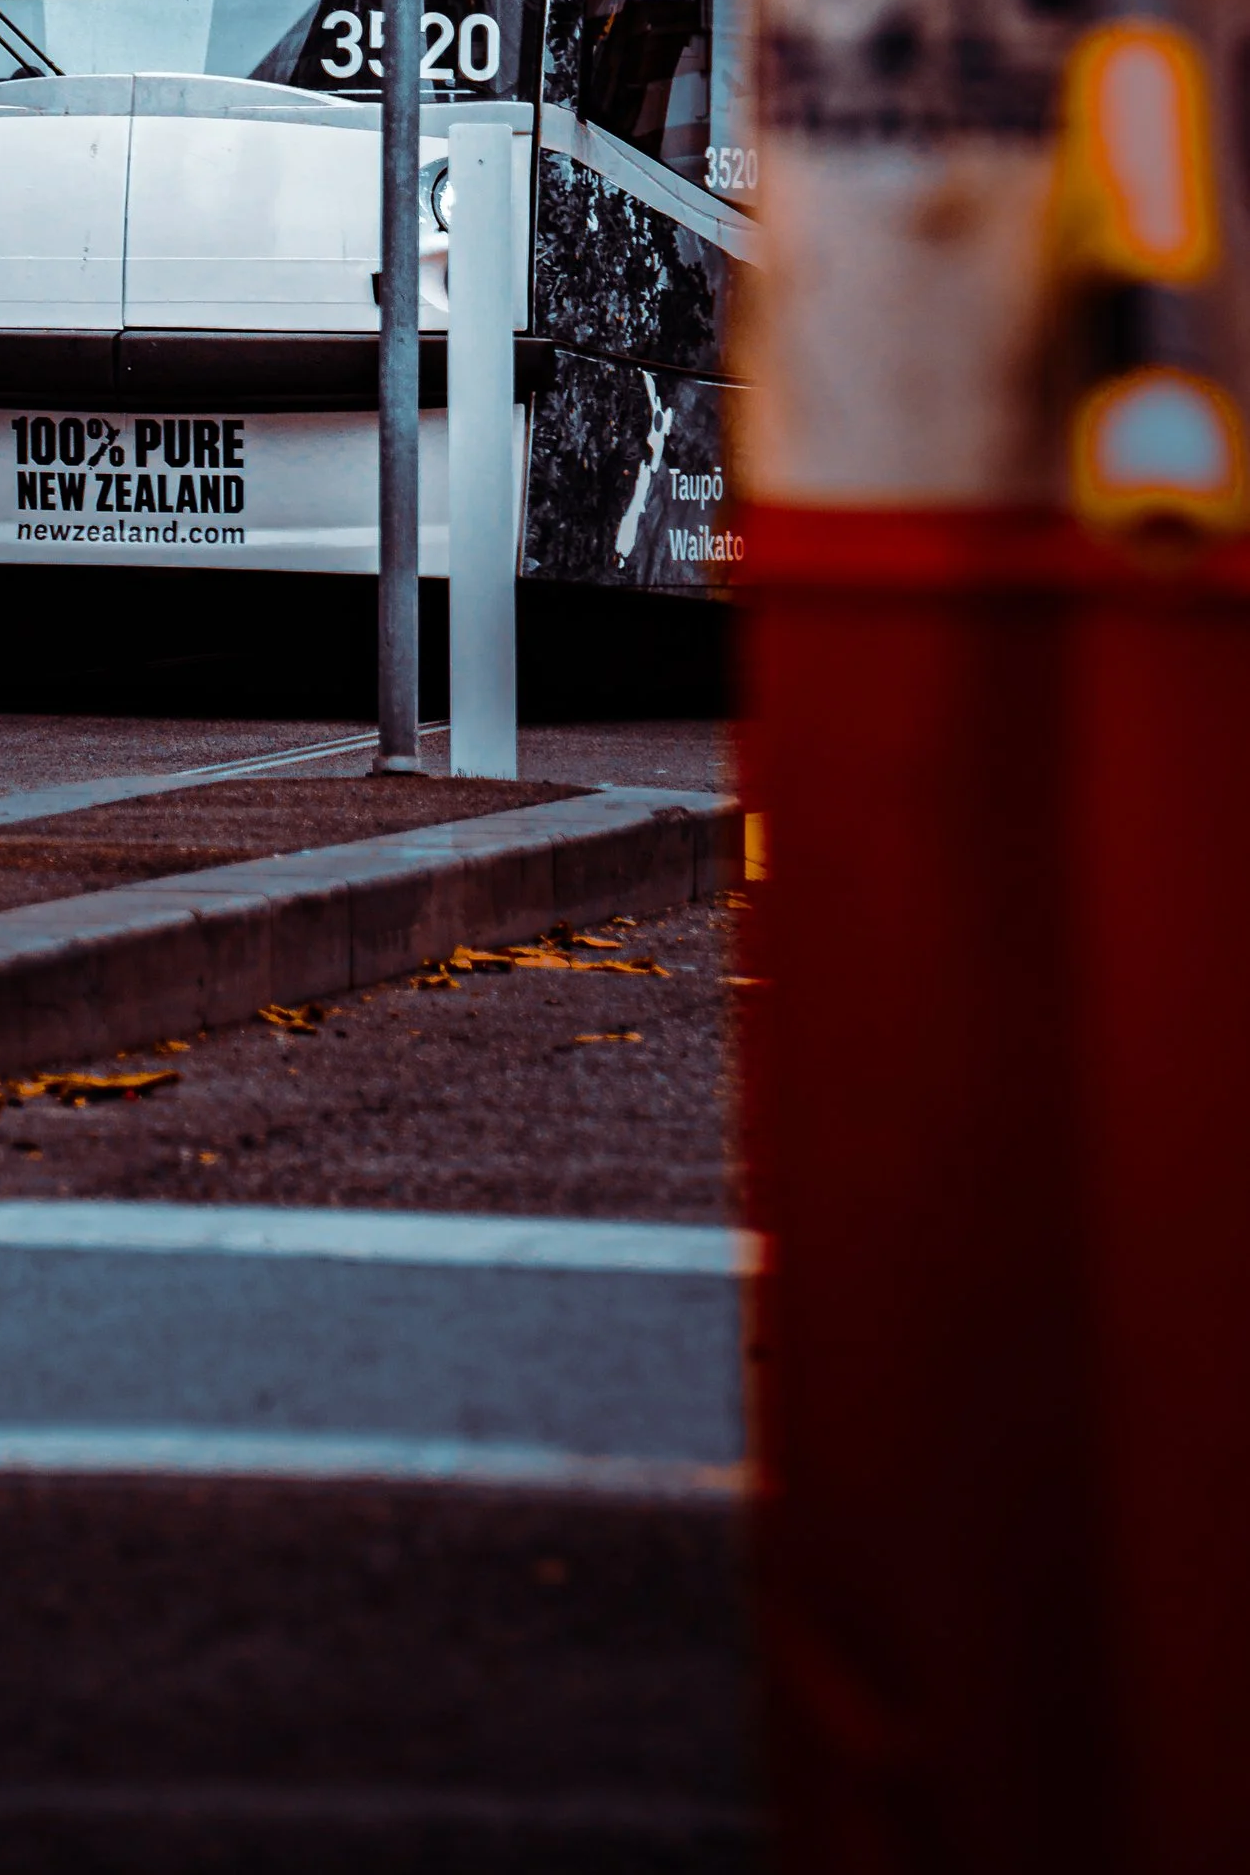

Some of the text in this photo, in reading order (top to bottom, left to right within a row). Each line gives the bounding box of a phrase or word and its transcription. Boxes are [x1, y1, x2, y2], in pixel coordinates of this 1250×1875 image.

[704, 146, 759, 189] 3520
[11, 416, 245, 469] 100% PURE
[17, 471, 245, 514] NEW ZEALAND
[17, 519, 245, 545] newzealand.com
[669, 525, 745, 562] Waikato
